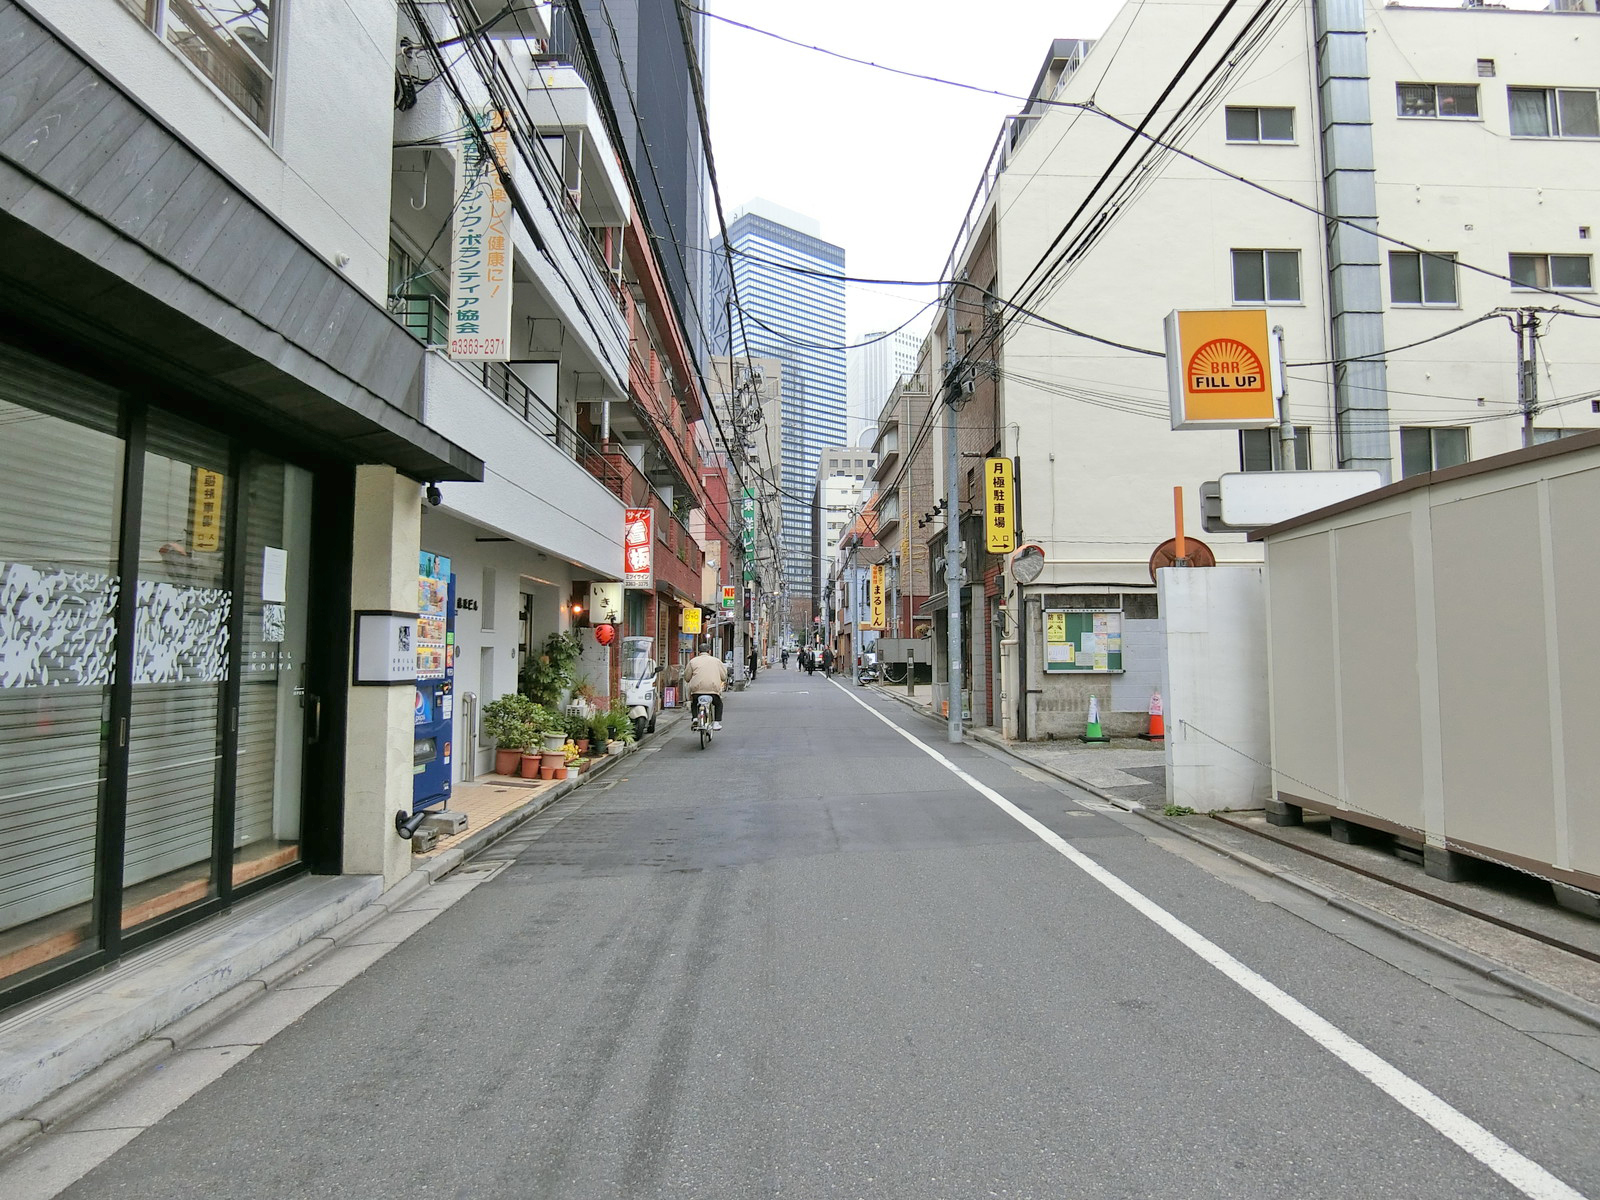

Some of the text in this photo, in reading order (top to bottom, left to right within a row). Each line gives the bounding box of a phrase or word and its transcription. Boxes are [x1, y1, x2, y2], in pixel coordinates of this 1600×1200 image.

[457, 338, 505, 354] 3363-2371
[1210, 361, 1240, 374] BAR
[1195, 376, 1257, 388] FILL UP
[993, 462, 1006, 528] 月極駐車場
[626, 511, 650, 520] サイン
[991, 534, 1009, 542] 入口
[724, 588, 735, 597] NP
[873, 585, 883, 626] まるしん
[251, 651, 292, 659] GRILL
[251, 663, 292, 671] KONYA
